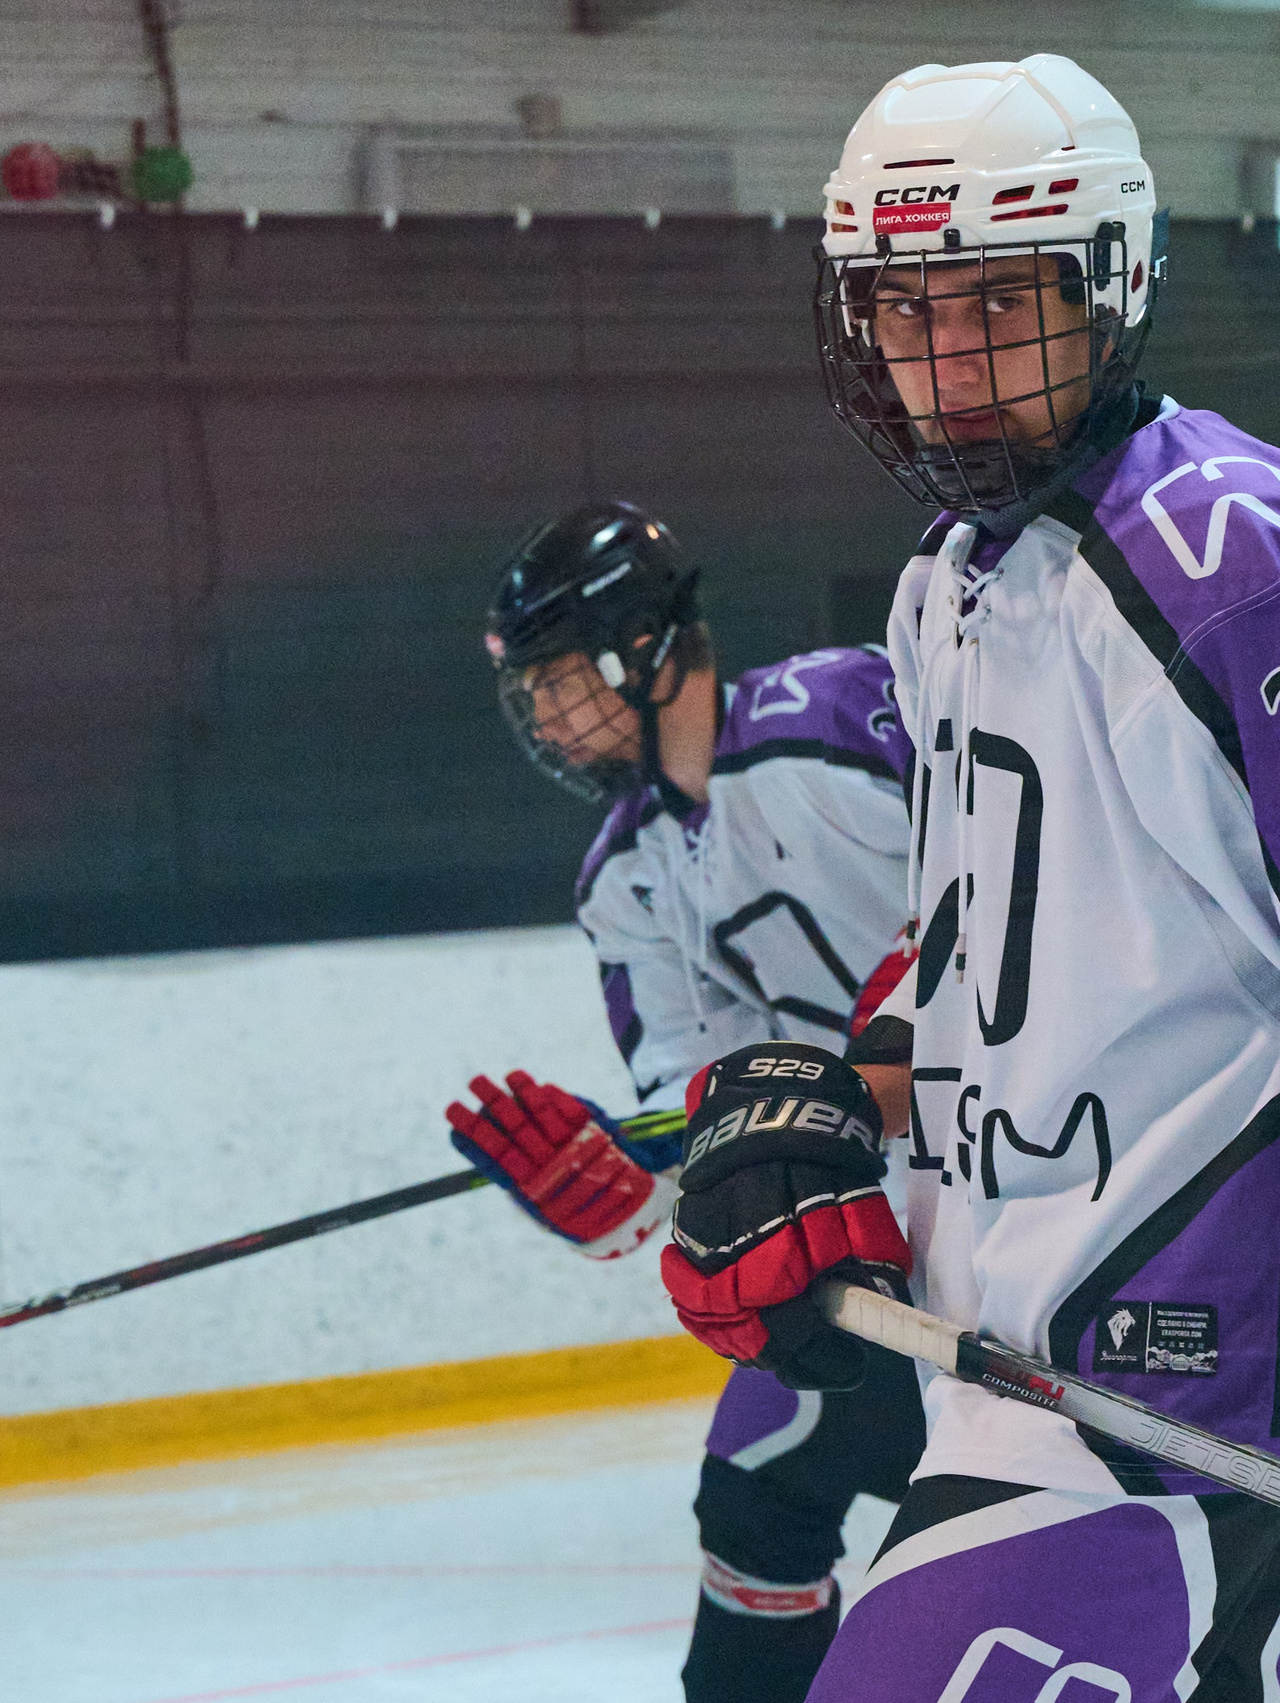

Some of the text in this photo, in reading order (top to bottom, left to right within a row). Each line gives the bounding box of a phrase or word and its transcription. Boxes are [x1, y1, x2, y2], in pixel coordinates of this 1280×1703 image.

[874, 183, 961, 206] CCM
[1120, 180, 1146, 194] CCM
[875, 212, 950, 226] ЛИГА ХОККЕЯ
[739, 1058, 824, 1081] S29
[982, 1373, 1059, 1409] COMPOSITE
